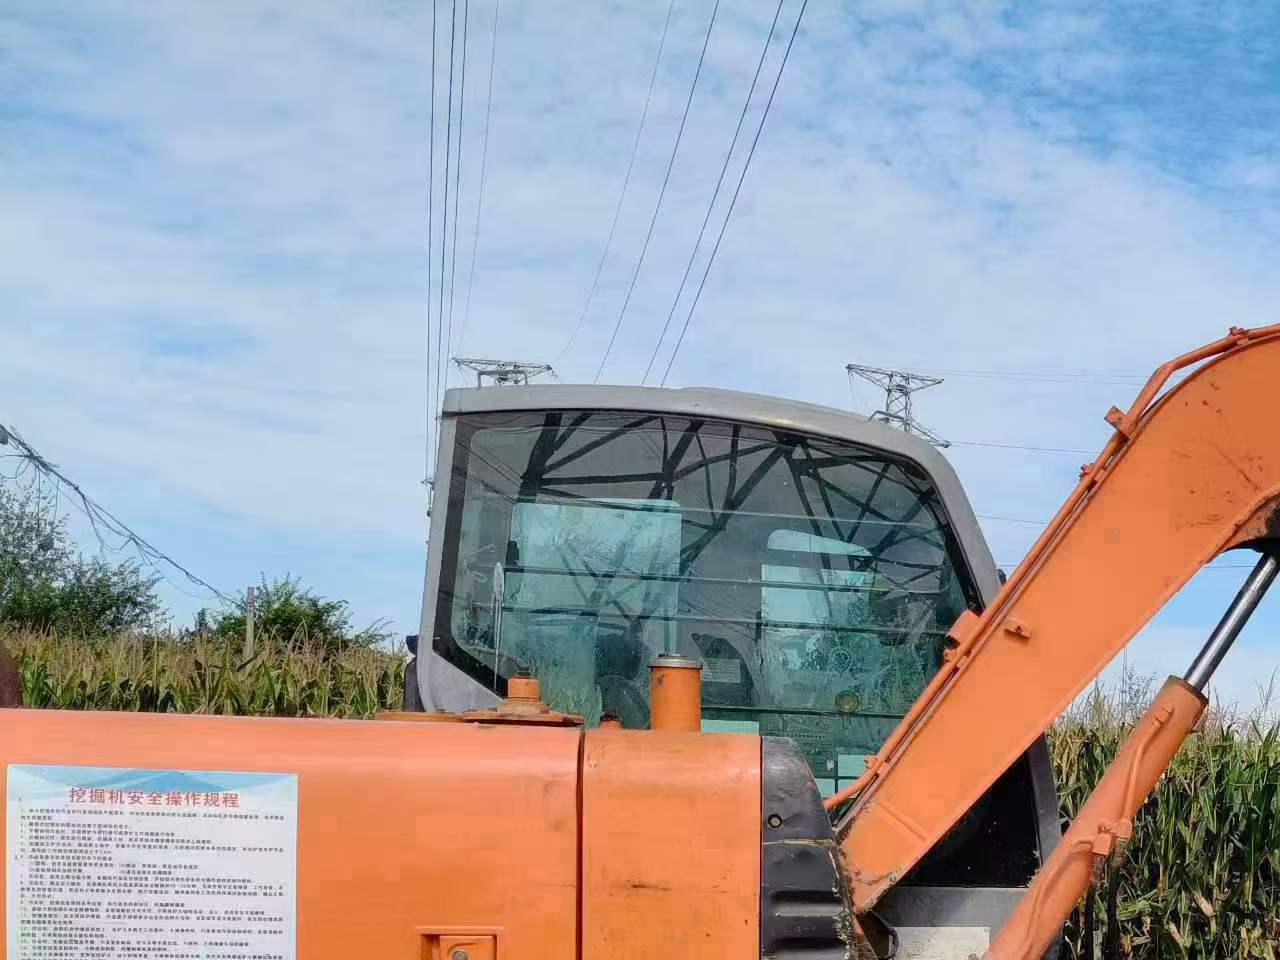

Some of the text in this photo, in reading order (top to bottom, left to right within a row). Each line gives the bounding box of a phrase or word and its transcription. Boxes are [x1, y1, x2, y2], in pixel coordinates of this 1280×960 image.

[69, 787, 240, 808] 挖掘机安全操作规程
